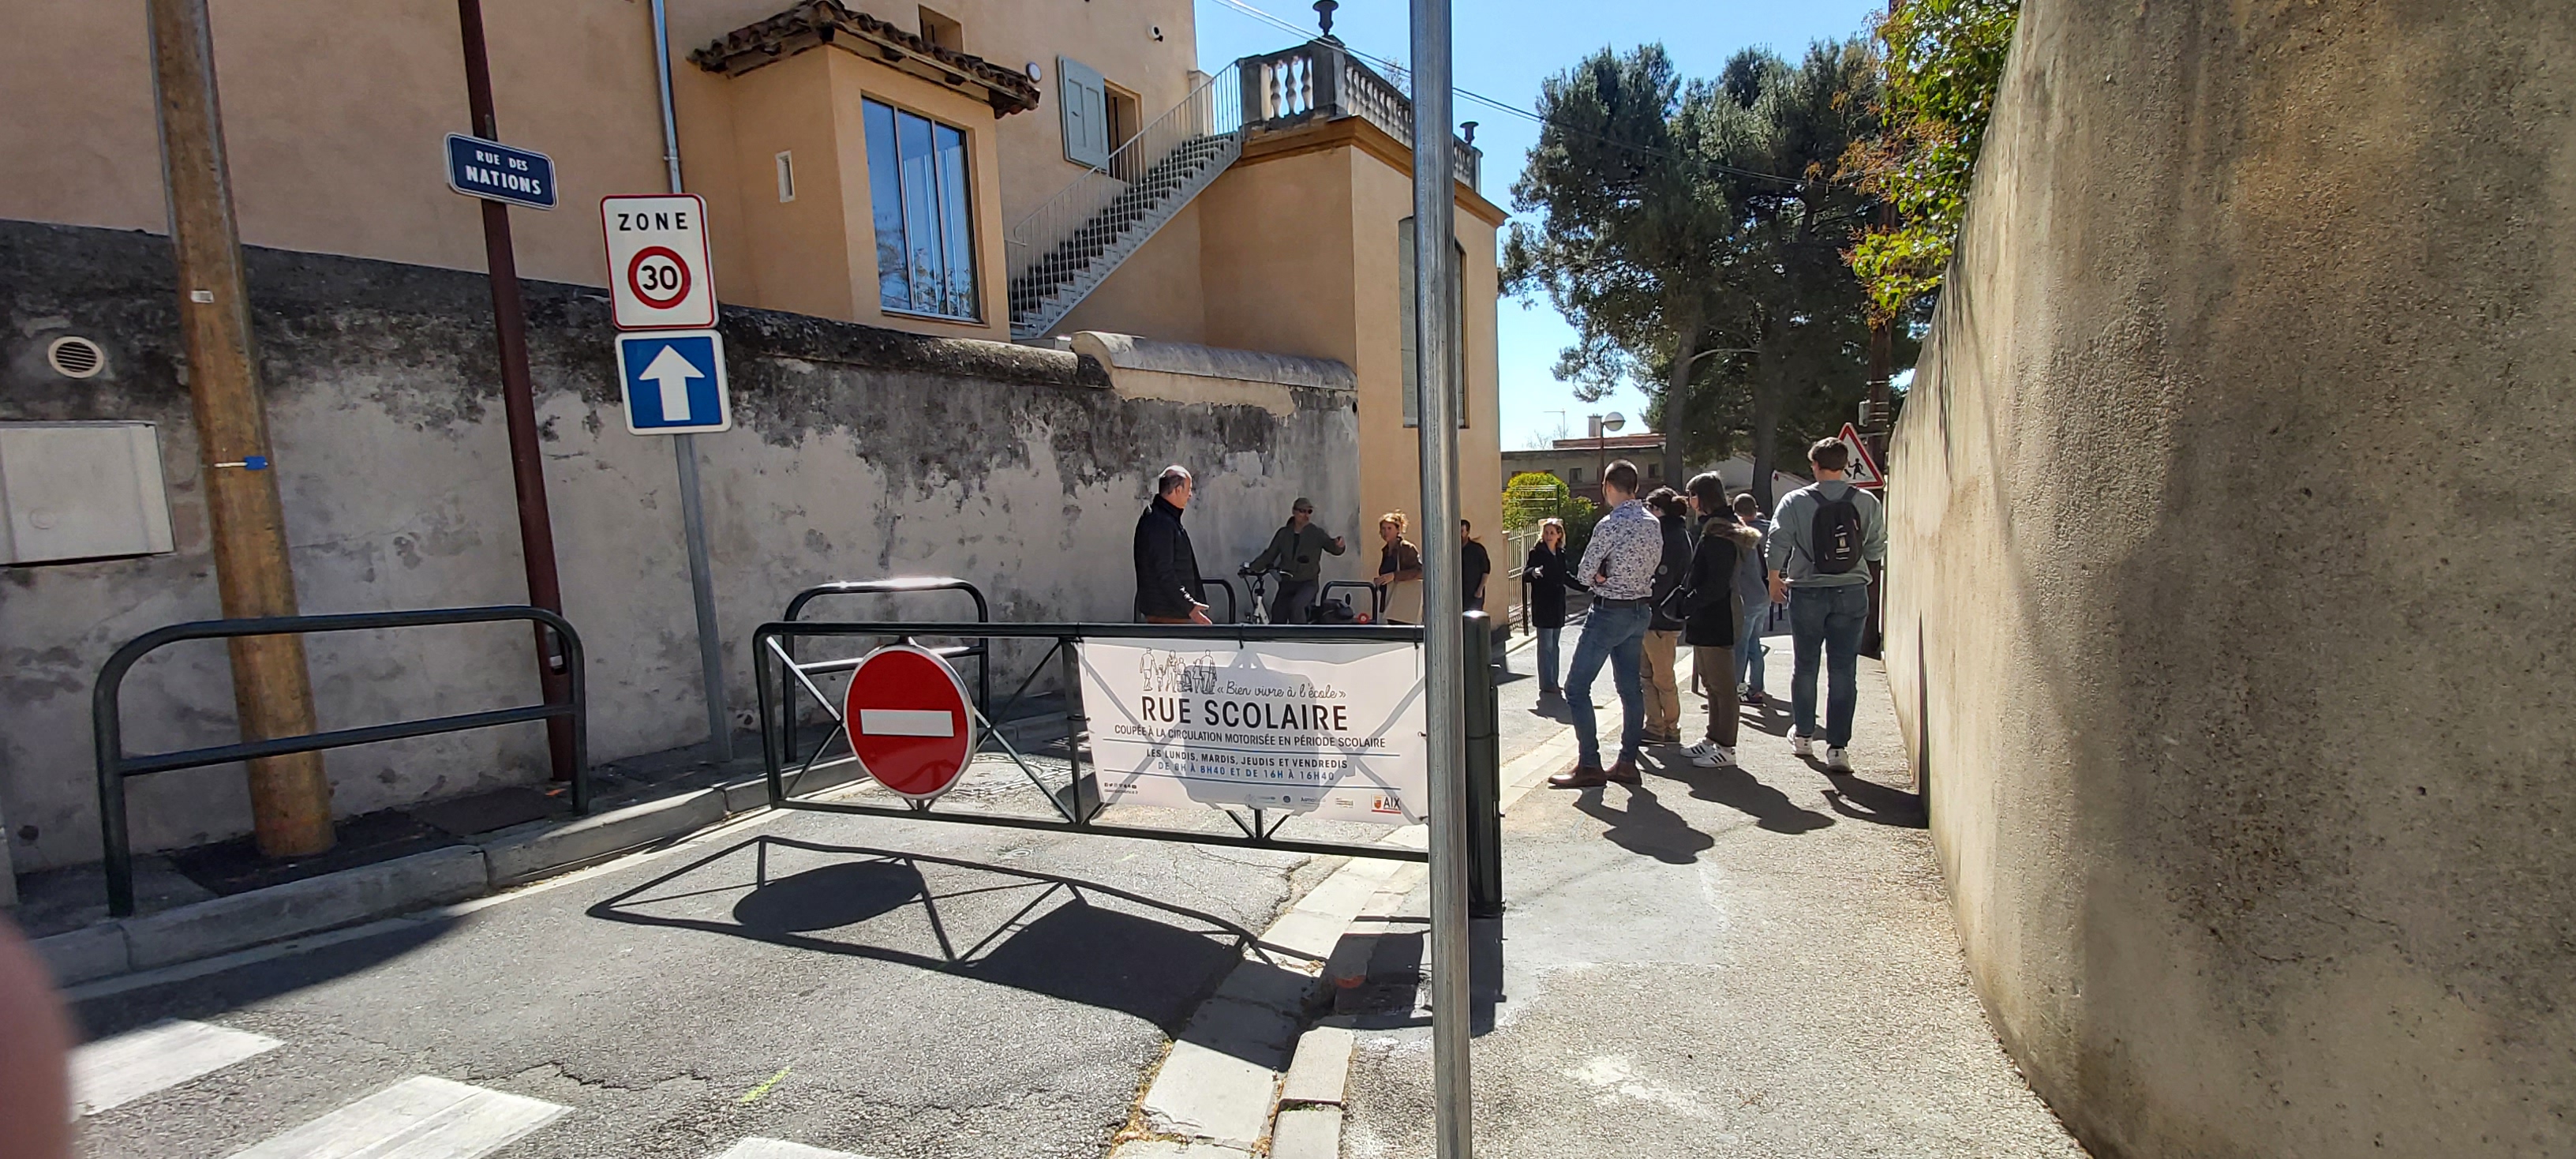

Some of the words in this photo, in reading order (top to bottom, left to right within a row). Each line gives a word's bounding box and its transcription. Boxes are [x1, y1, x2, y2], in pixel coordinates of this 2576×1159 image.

[476, 150, 500, 165] RUE
[508, 157, 529, 171] DES
[466, 164, 541, 195] NATIONS
[617, 212, 688, 231] ZONE
[641, 265, 678, 291] 30
[1255, 685, 1285, 698] vivre
[1287, 686, 1296, 699] à
[1141, 696, 1191, 724] RUE
[1204, 700, 1348, 731] SCOLAIRE
[1114, 724, 1147, 737] COUPÉE
[1148, 726, 1155, 737] À
[1156, 728, 1166, 738] LA
[1168, 729, 1222, 742] CIRCULATION
[1225, 733, 1275, 746] MOTORISÉE
[1279, 736, 1291, 746] EN
[1294, 734, 1335, 747] PÉRIODE
[1338, 737, 1386, 748] SCOLAIRE
[1147, 748, 1162, 758] LES
[1165, 750, 1199, 762] LUNDIS,
[1201, 753, 1238, 765] MARDIS,
[1241, 756, 1275, 767] JEUDIS
[1279, 758, 1289, 767] ET
[1292, 758, 1348, 769] VENDREDIS
[1158, 761, 1170, 770] DE
[1190, 762, 1196, 773] À
[1200, 765, 1225, 775] 8H40
[1230, 767, 1241, 776] ET
[1245, 769, 1258, 778] DE
[1264, 769, 1283, 778] 16H
[1288, 768, 1294, 779] À
[1300, 771, 1335, 781] 16H40
[1383, 797, 1401, 808] AIX
